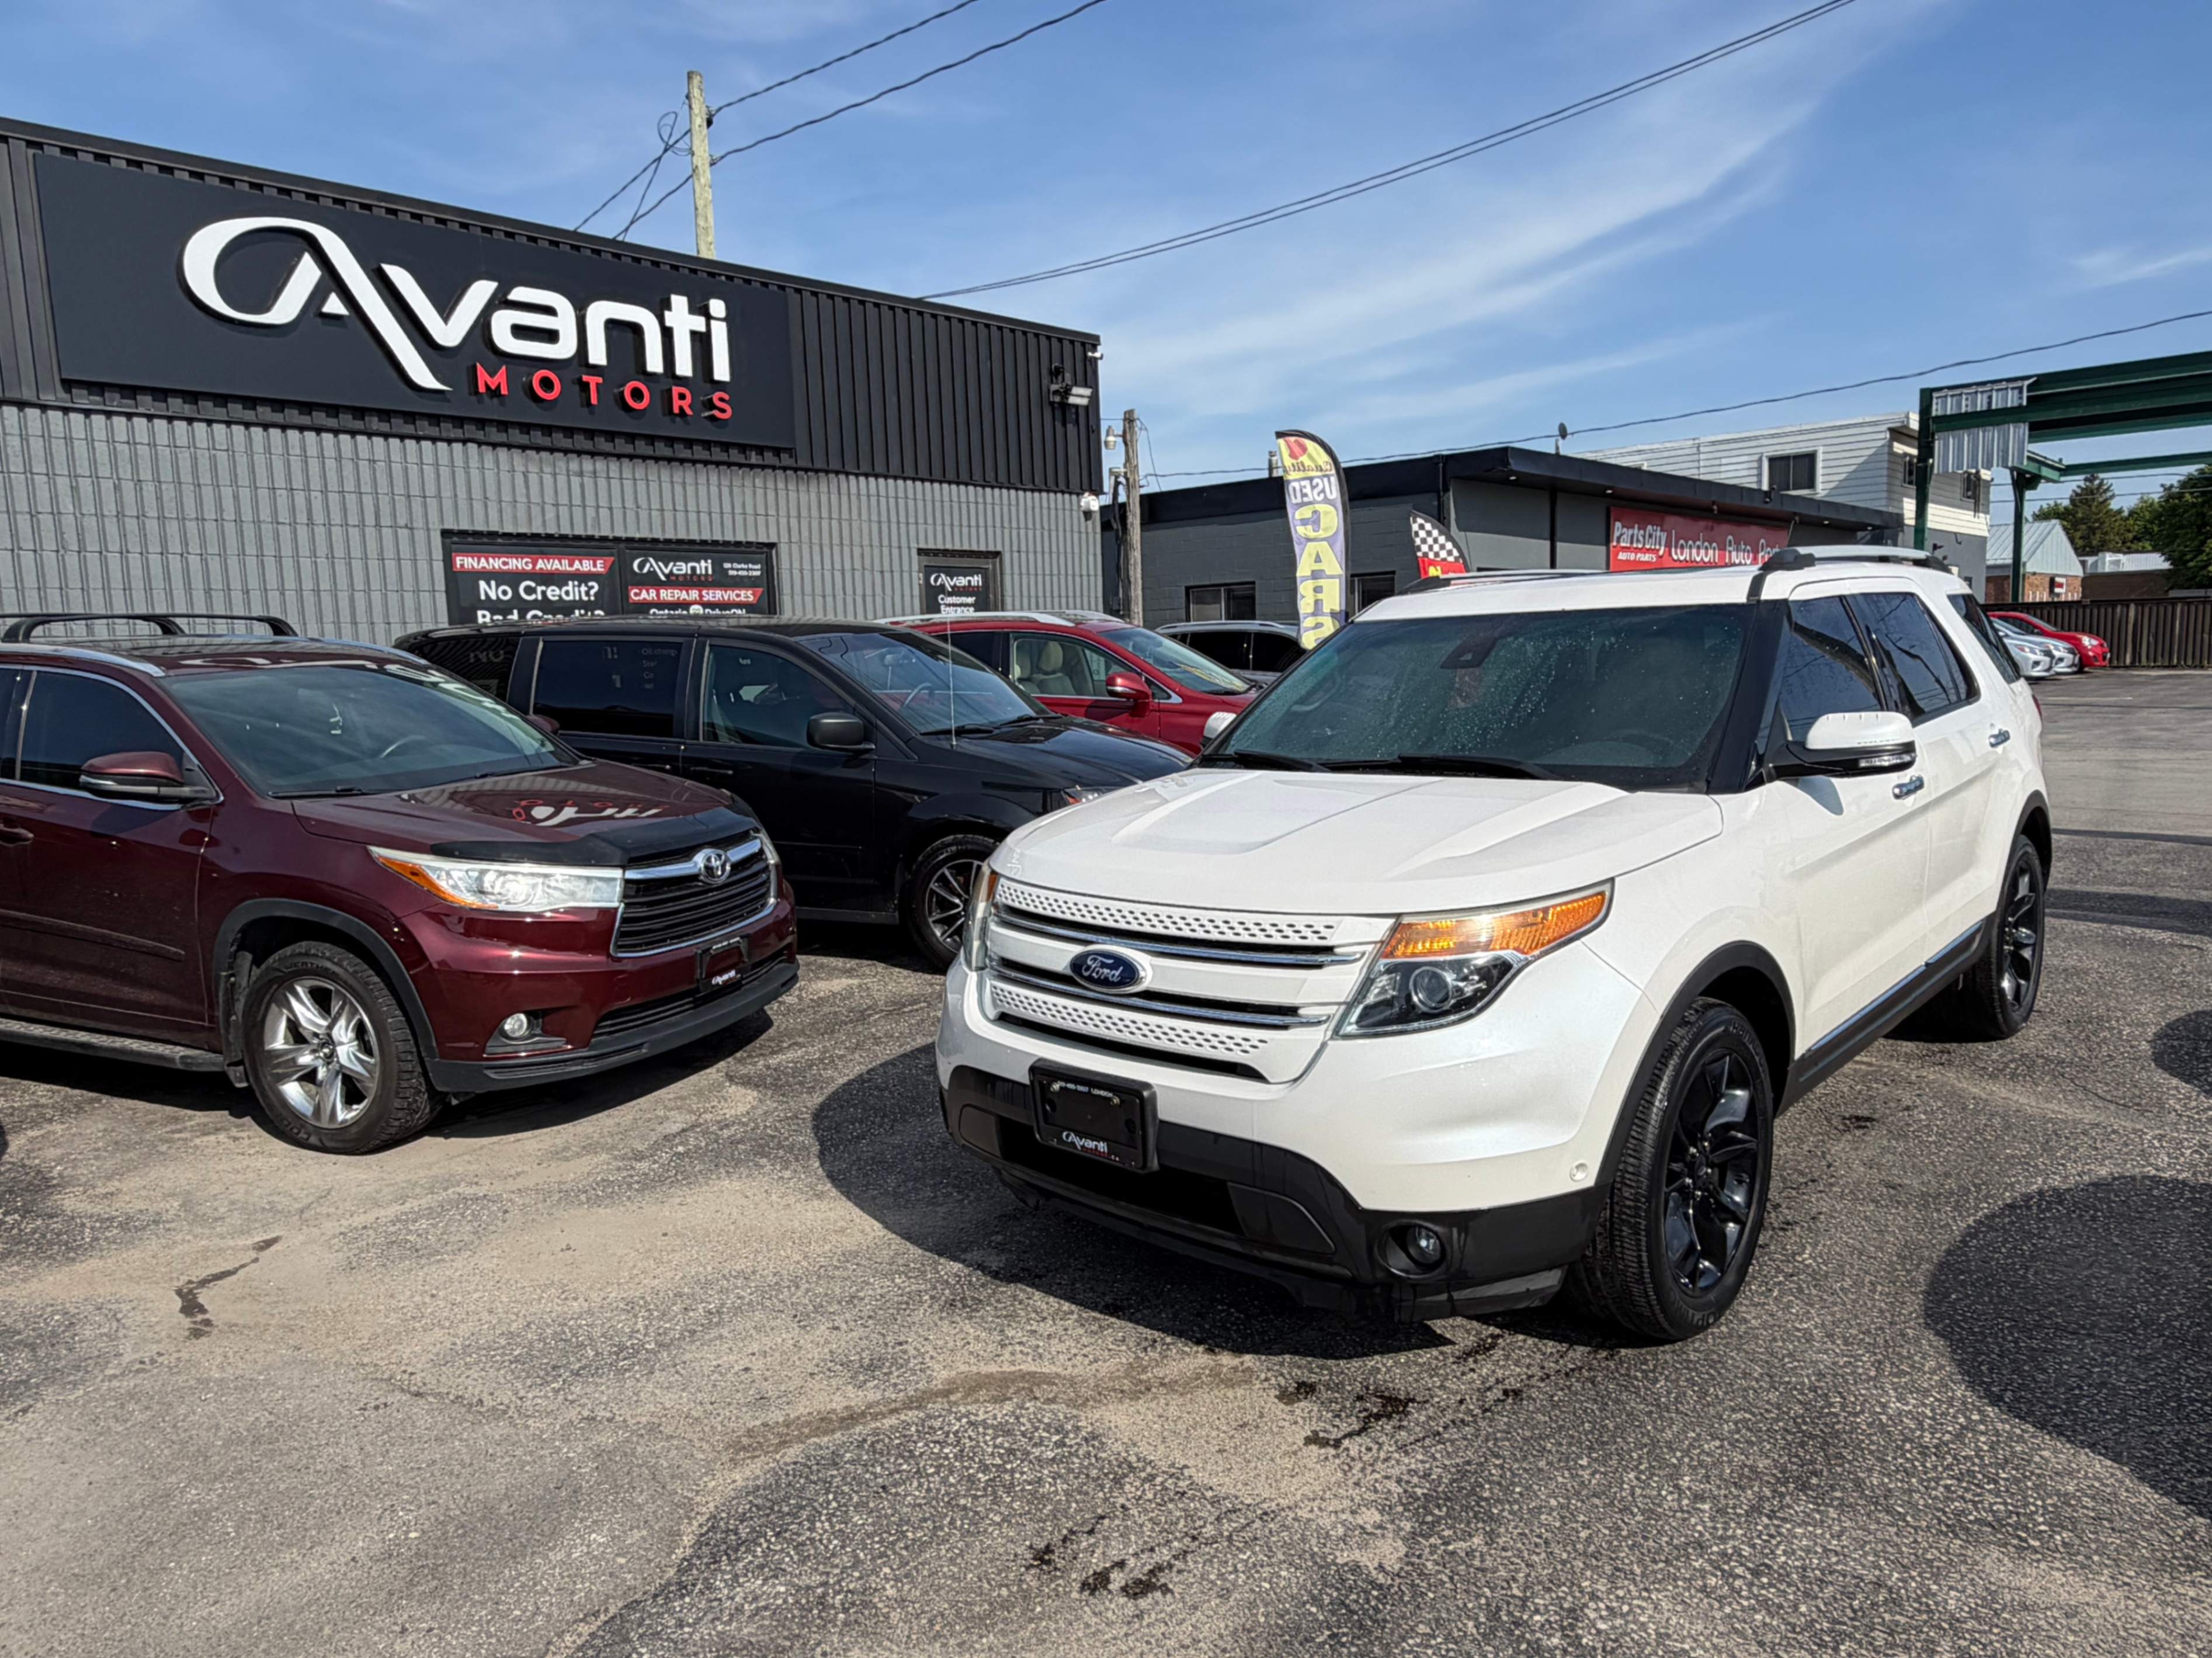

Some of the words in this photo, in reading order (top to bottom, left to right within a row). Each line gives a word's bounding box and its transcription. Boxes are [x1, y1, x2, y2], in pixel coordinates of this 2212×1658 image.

[182, 217, 731, 391] Avanti
[476, 363, 732, 420] MOTORS
[1617, 551, 1635, 561] AUTO
[1636, 553, 1657, 562] PARTS
[1671, 530, 1718, 563] London
[1725, 535, 1752, 565] Auto
[456, 557, 532, 570] FINANCING
[536, 559, 605, 571] AVAILABLE
[633, 557, 712, 581] Avanti
[478, 580, 512, 601] No
[519, 581, 599, 601] Credit?
[930, 573, 982, 592] Avanti
[631, 589, 657, 600] CAR
[660, 589, 699, 601] REPAIR
[702, 591, 753, 601] SERVICES
[938, 595, 976, 604] Customer
[940, 605, 975, 614] Entrance
[1082, 955, 1124, 983] Ford
[1062, 1130, 1108, 1153] Avanti
